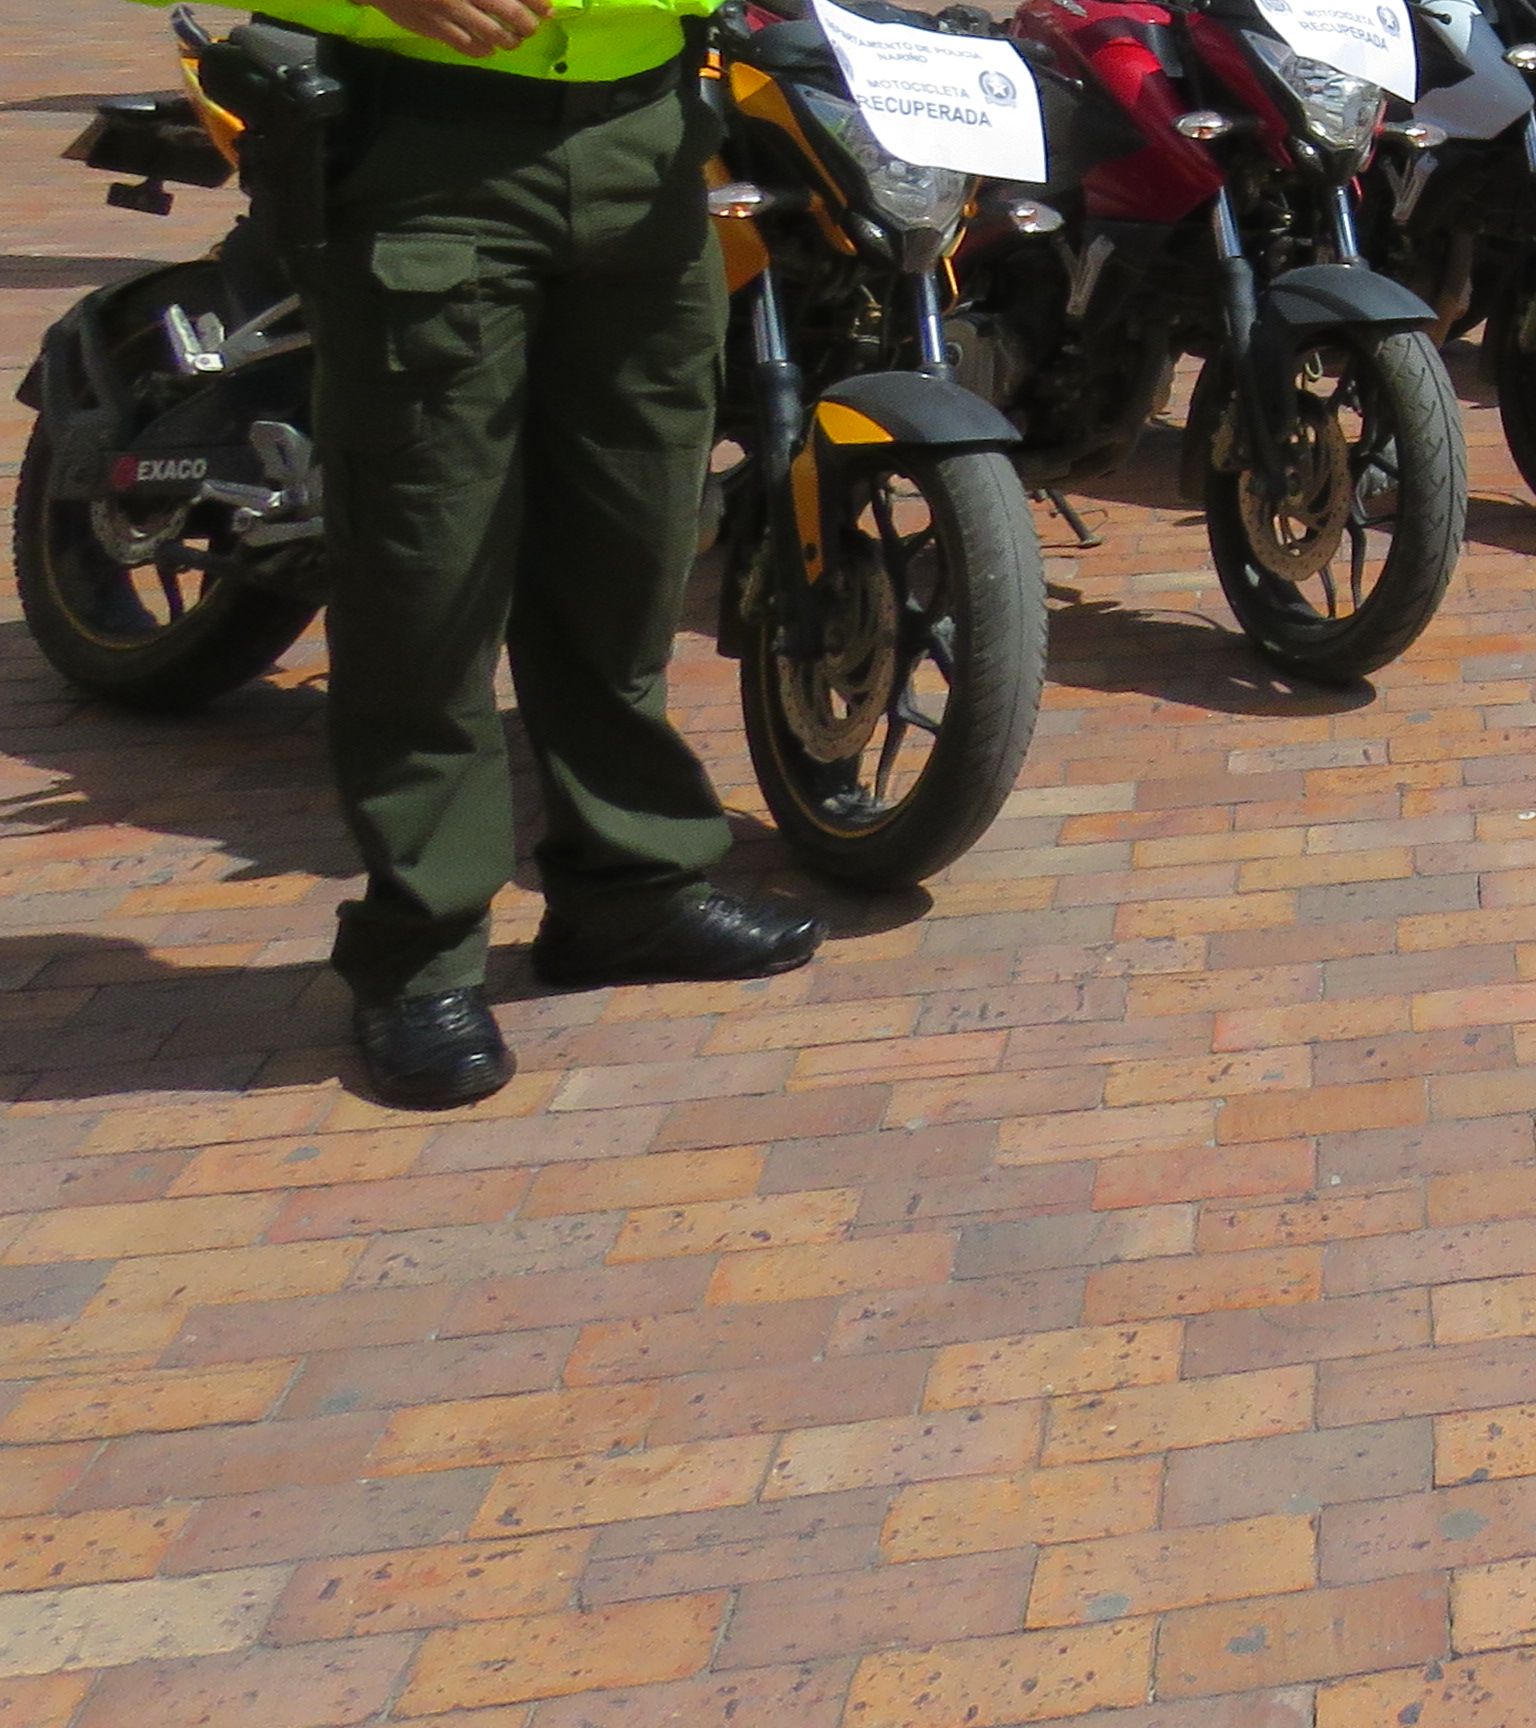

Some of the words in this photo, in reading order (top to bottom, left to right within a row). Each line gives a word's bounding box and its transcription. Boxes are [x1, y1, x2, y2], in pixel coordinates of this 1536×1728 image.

[1298, 21, 1389, 52] RECUPERADA
[866, 78, 970, 99] MOTOCICLETA
[856, 94, 993, 128] RECUPERADA
